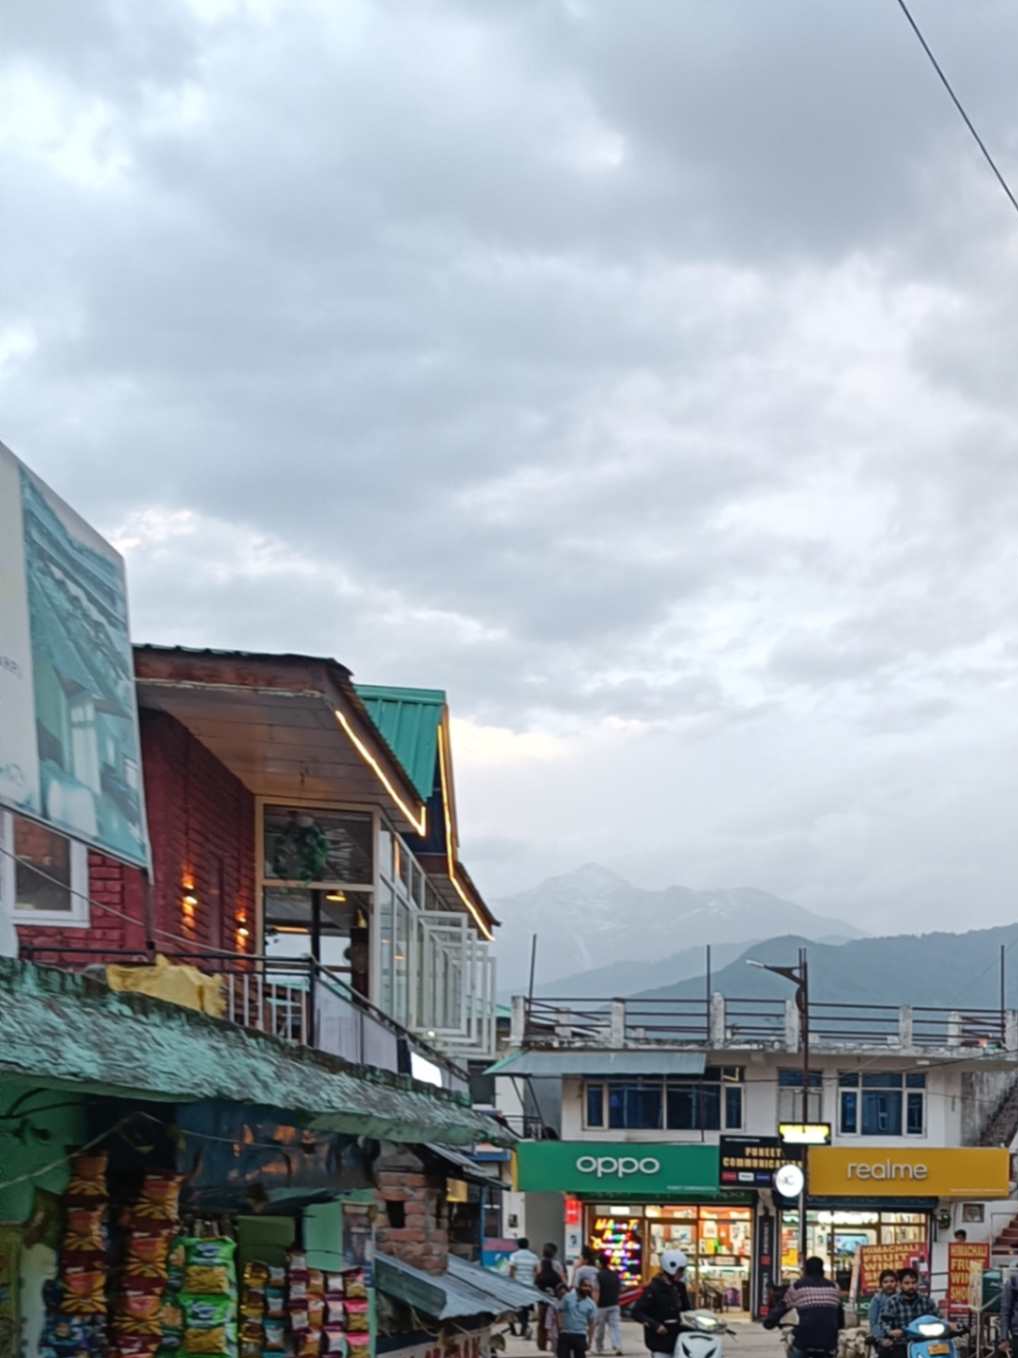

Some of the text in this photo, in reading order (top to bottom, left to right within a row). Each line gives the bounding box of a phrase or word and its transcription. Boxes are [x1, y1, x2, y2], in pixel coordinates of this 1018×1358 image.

[848, 1159, 928, 1180] realme
[863, 1244, 920, 1254] HIMACHALI
[863, 1252, 908, 1263] FRUIT
